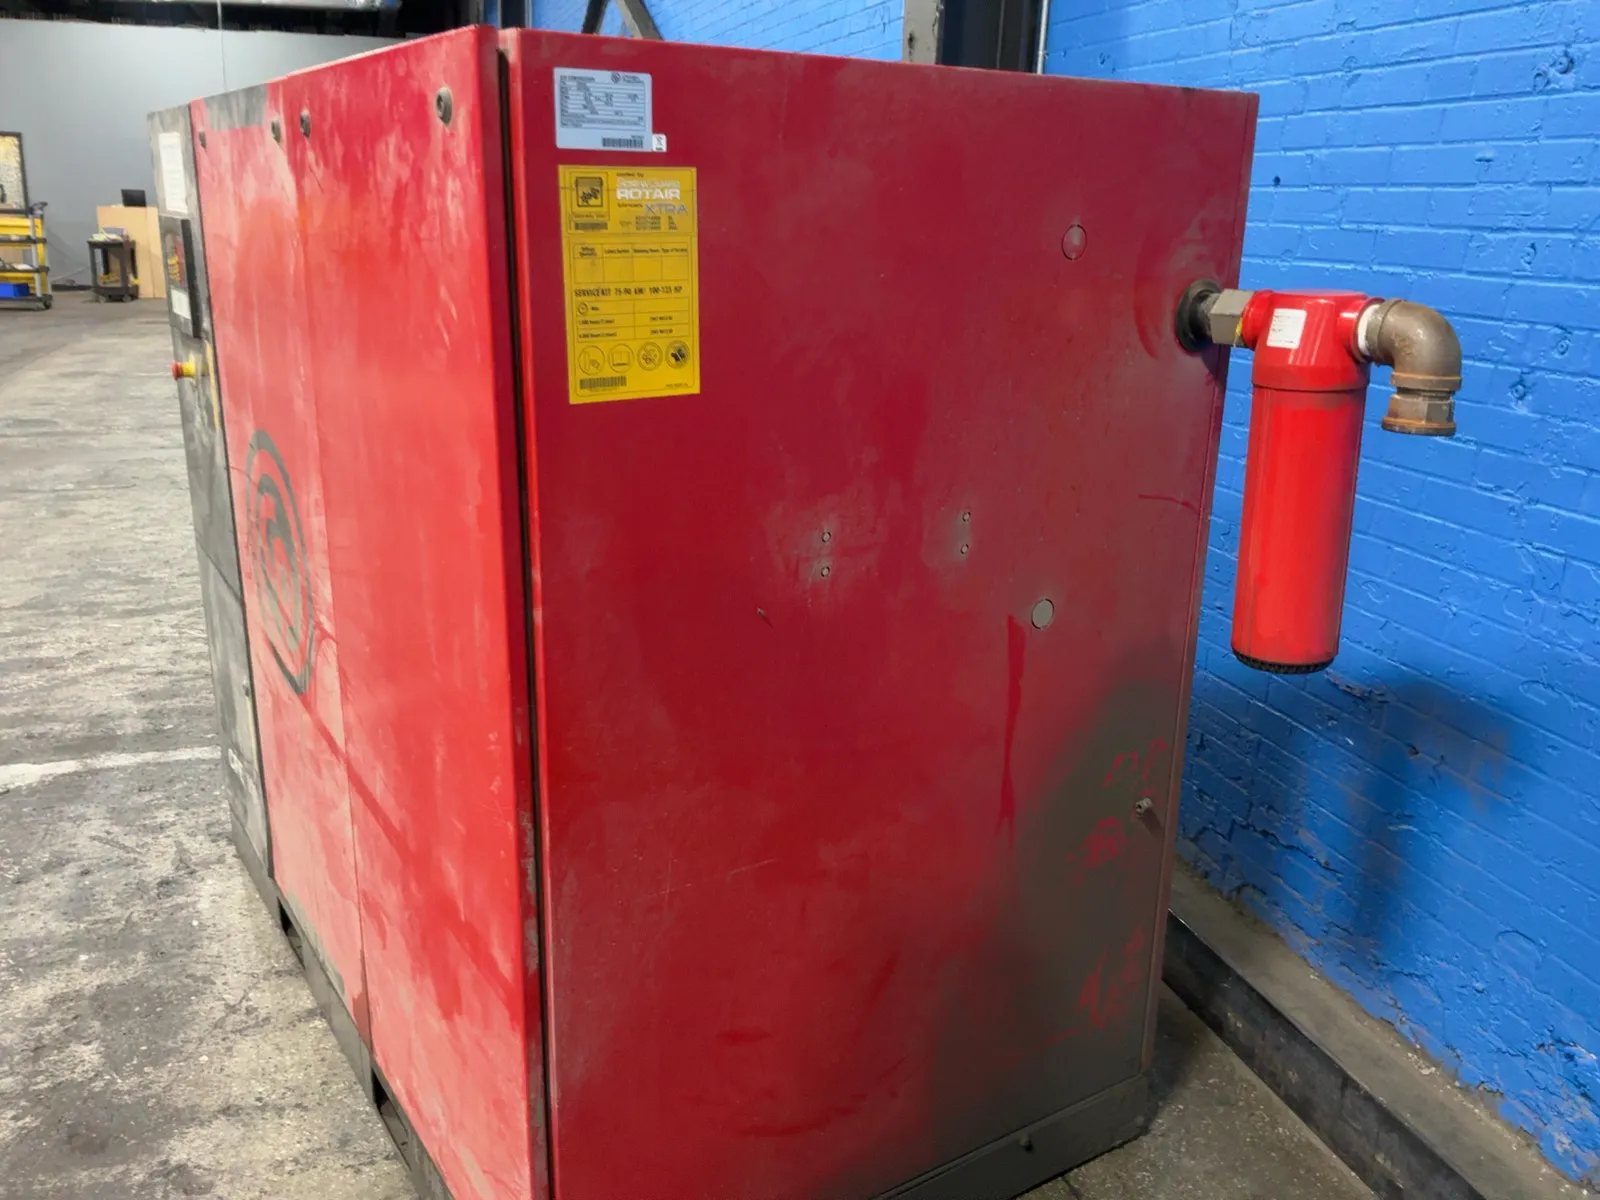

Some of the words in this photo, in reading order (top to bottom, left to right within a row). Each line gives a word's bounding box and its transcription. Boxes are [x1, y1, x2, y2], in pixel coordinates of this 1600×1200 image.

[616, 188, 681, 200] ROTAIR
[645, 203, 688, 216] XTRA
[574, 288, 600, 297] SERVICE
